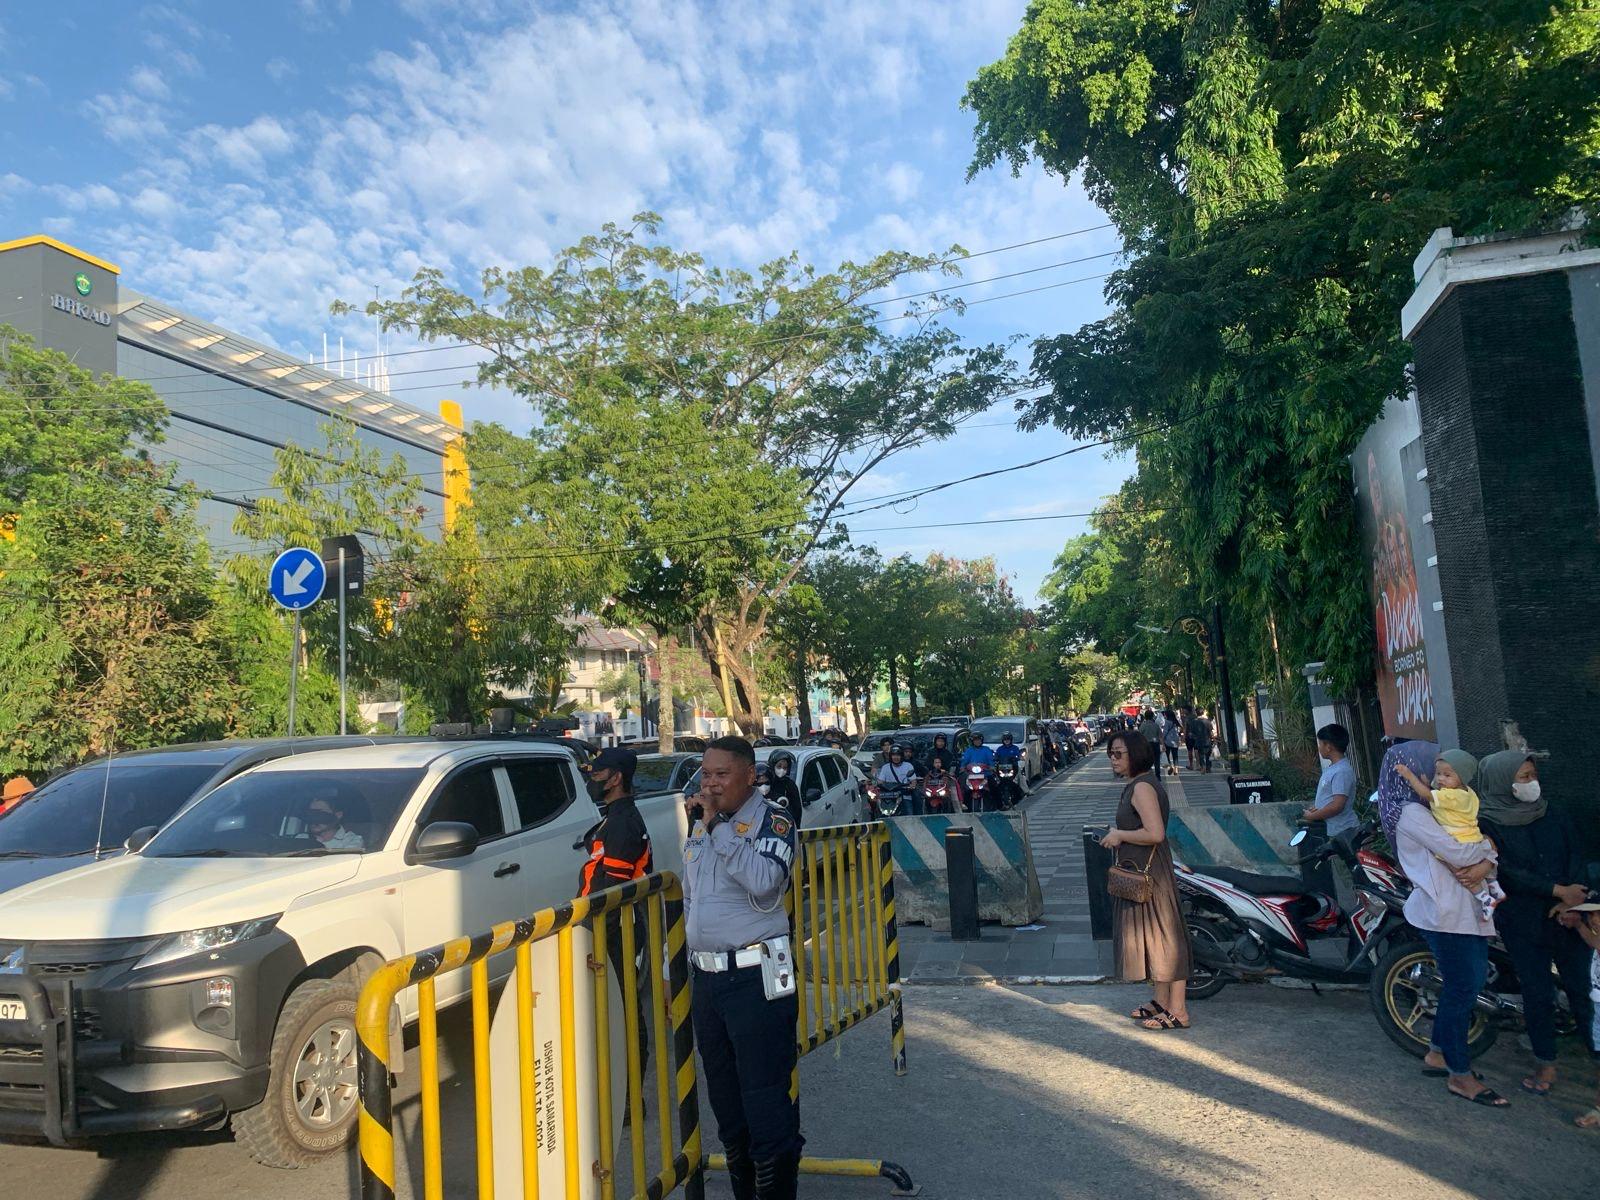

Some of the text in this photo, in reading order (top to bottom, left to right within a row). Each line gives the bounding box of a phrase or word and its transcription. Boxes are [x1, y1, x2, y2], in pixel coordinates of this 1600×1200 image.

[1394, 650, 1425, 673] BORNEO FC
[543, 1040, 557, 1155] DISHUB KOTA SAMARINDA
